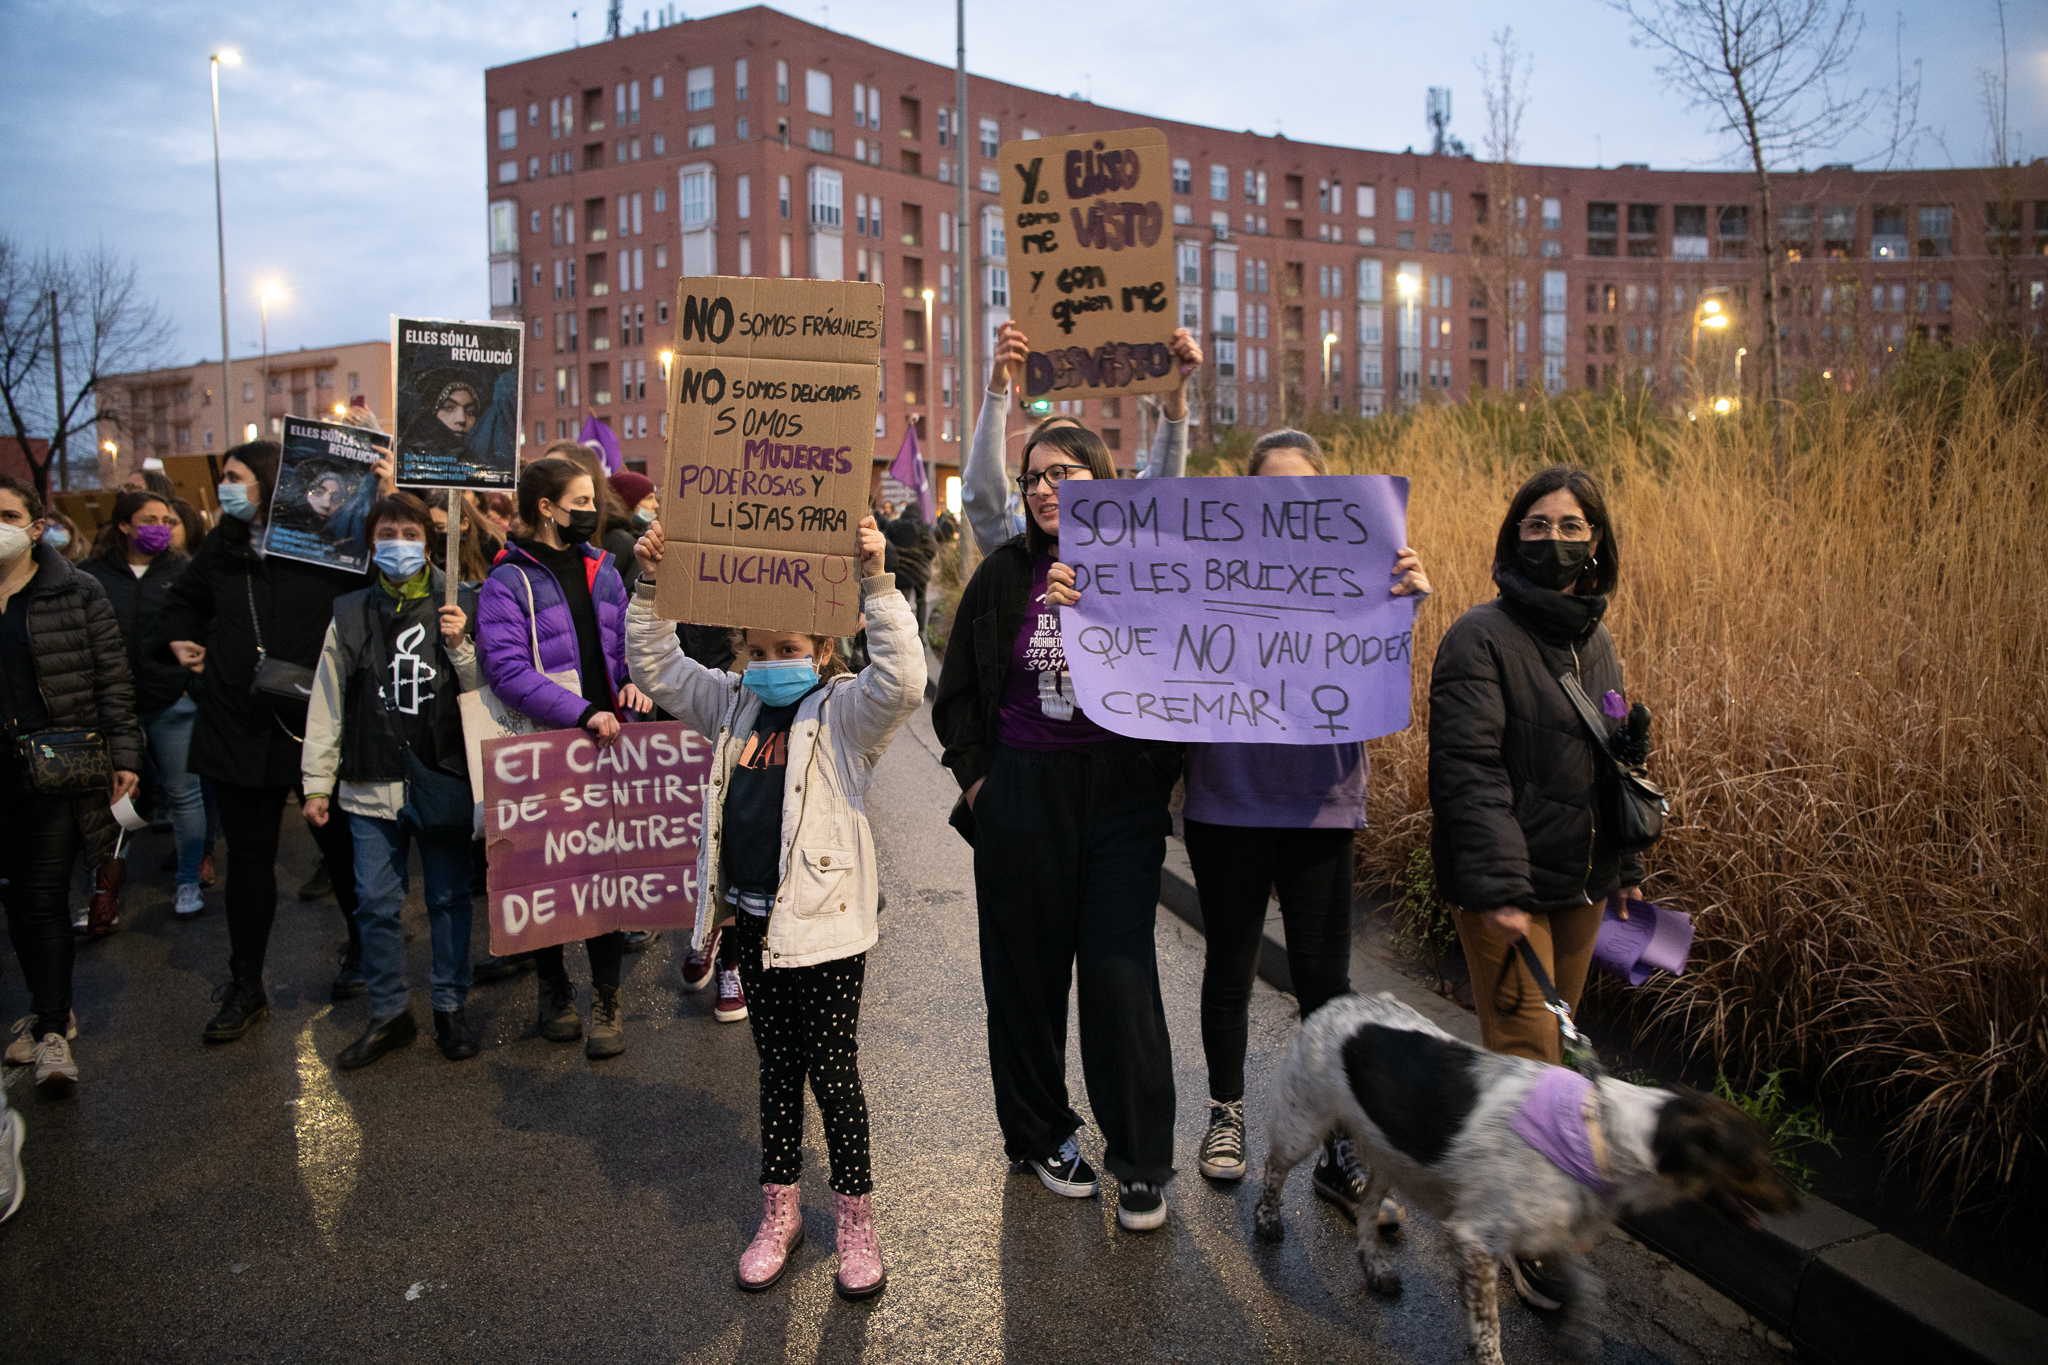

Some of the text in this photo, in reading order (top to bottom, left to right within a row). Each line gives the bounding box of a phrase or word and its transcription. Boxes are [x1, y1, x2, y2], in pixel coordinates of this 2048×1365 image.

[1056, 265, 1106, 294] con
[683, 295, 735, 344] NO
[739, 312, 797, 343] SOMOS
[405, 329, 479, 348] ELLES SÓN LA
[451, 347, 513, 365] REVOLUCIÓ
[680, 367, 726, 405] NO
[732, 379, 787, 400] SOMOS
[290, 424, 319, 439] ELLES
[714, 406, 803, 438] SOMOS
[744, 438, 852, 475] MUJERES
[680, 464, 824, 499] PODEROSAS Y
[797, 506, 847, 532] PARA
[1071, 497, 1368, 548] SOM LES NETES
[699, 552, 814, 591] LUCHAR
[1073, 559, 1364, 598] DE LES BRUIXES
[1078, 624, 1412, 674] QUE NO VAU PODER
[1101, 679, 1287, 731] CREMAR!
[494, 741, 552, 784] ET
[497, 794, 547, 831] DE
[502, 888, 556, 936] DE
